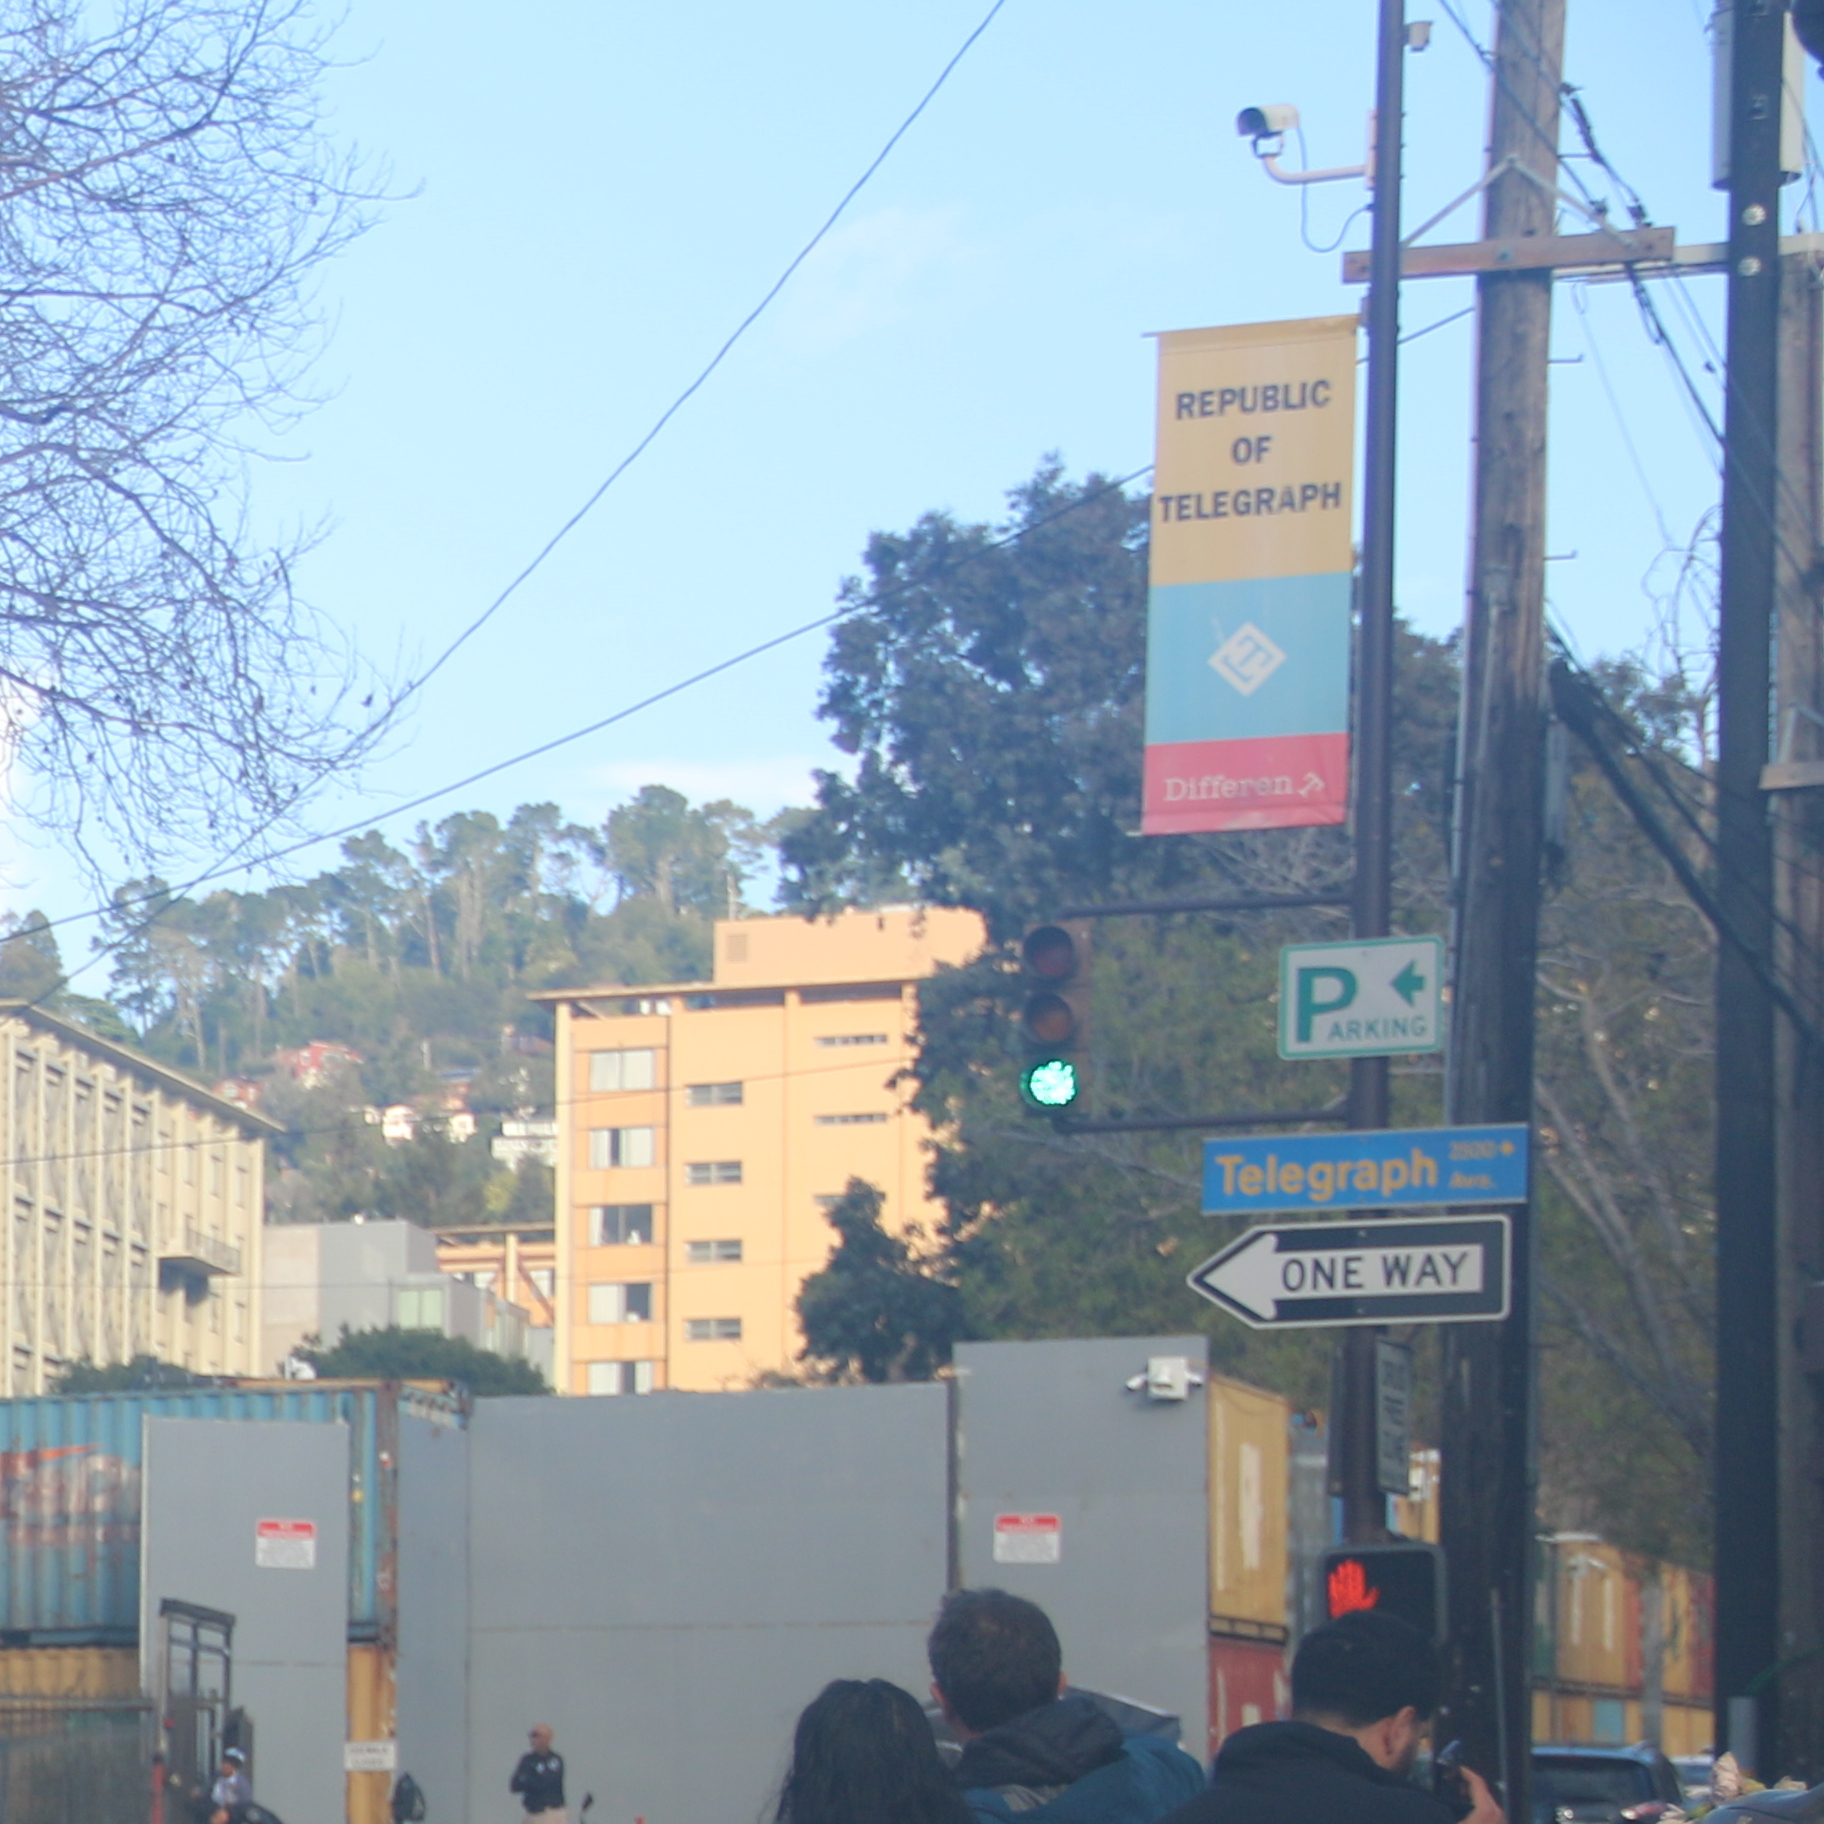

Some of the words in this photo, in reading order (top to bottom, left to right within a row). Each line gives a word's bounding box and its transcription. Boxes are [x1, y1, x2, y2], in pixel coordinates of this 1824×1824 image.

[1175, 380, 1332, 420] REPUBLIC
[1232, 436, 1272, 465] OF
[1160, 482, 1341, 522] TELEGRAPH
[1295, 965, 1428, 1044] PARKING
[1214, 1149, 1438, 1202] Telegraph
[1282, 1257, 1365, 1294] ONE
[1381, 1253, 1469, 1288] WAY
